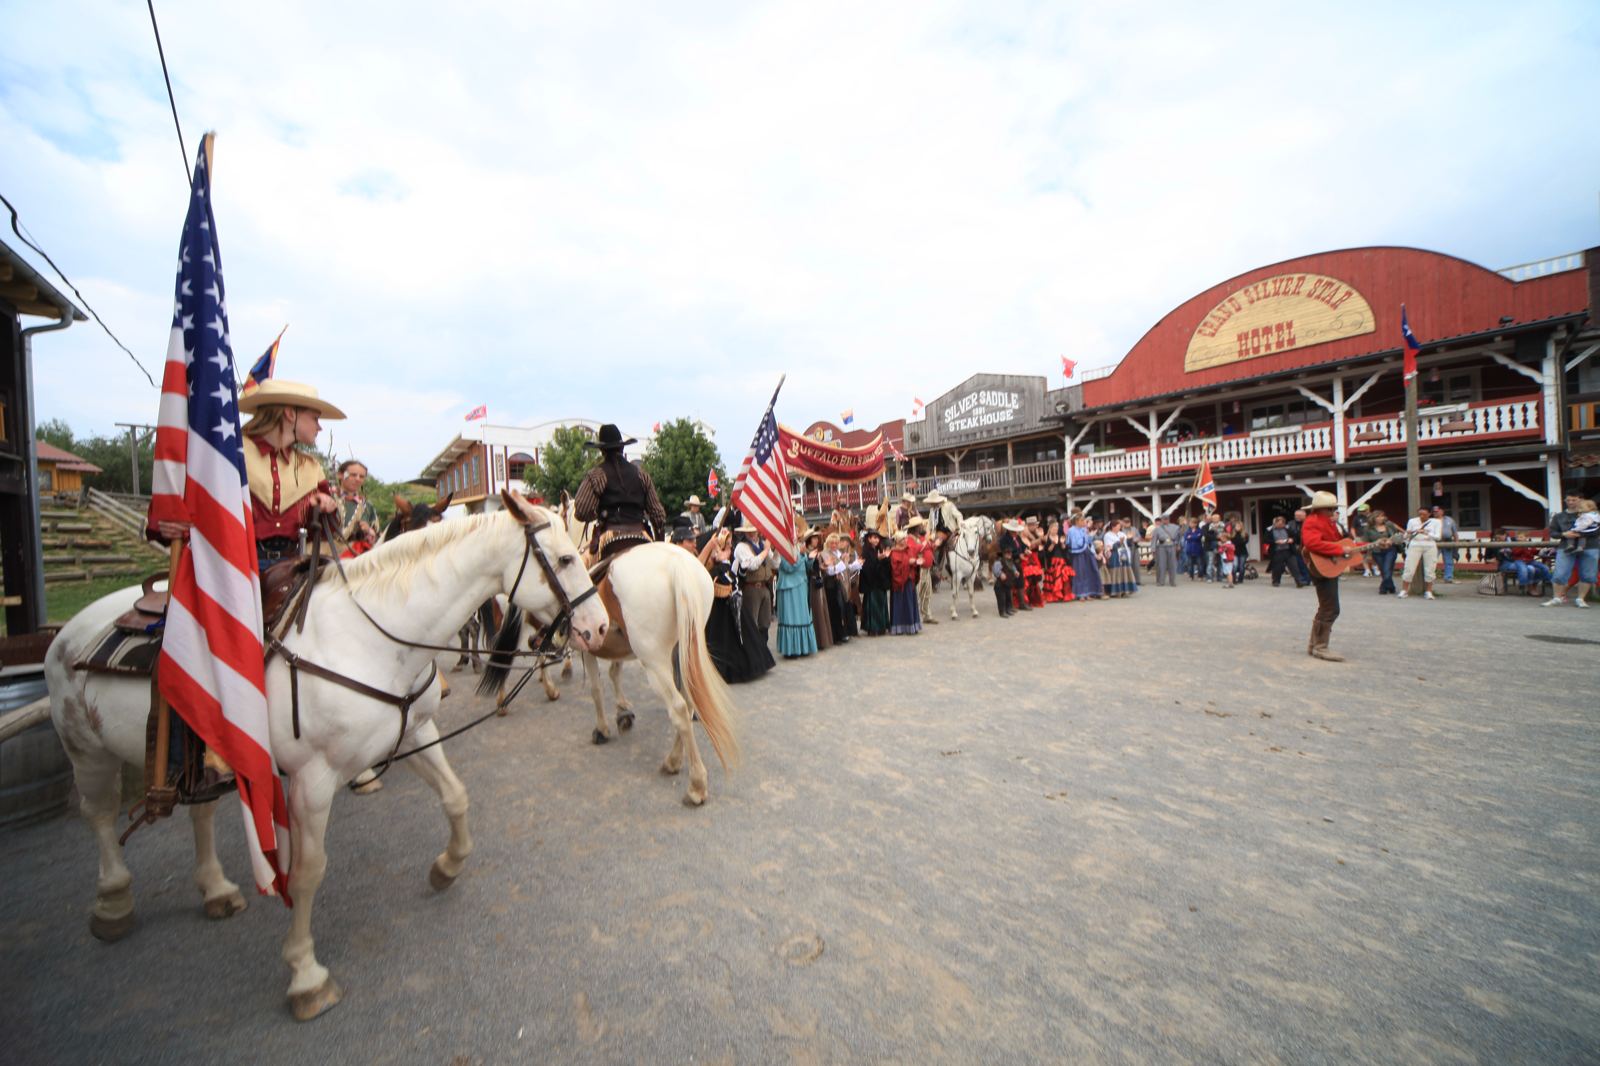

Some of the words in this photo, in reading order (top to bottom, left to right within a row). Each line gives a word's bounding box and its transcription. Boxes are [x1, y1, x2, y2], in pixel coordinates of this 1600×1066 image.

[1197, 296, 1242, 338] GRAND
[1244, 275, 1306, 304] SILVER
[1306, 278, 1353, 311] STAR
[1237, 320, 1296, 358] HOTEL
[944, 391, 978, 424] SILVER
[979, 390, 1019, 409] SADDLE
[949, 416, 979, 432] STEAK
[980, 408, 1014, 426] HOUSE
[787, 439, 838, 464] BUFFALO
